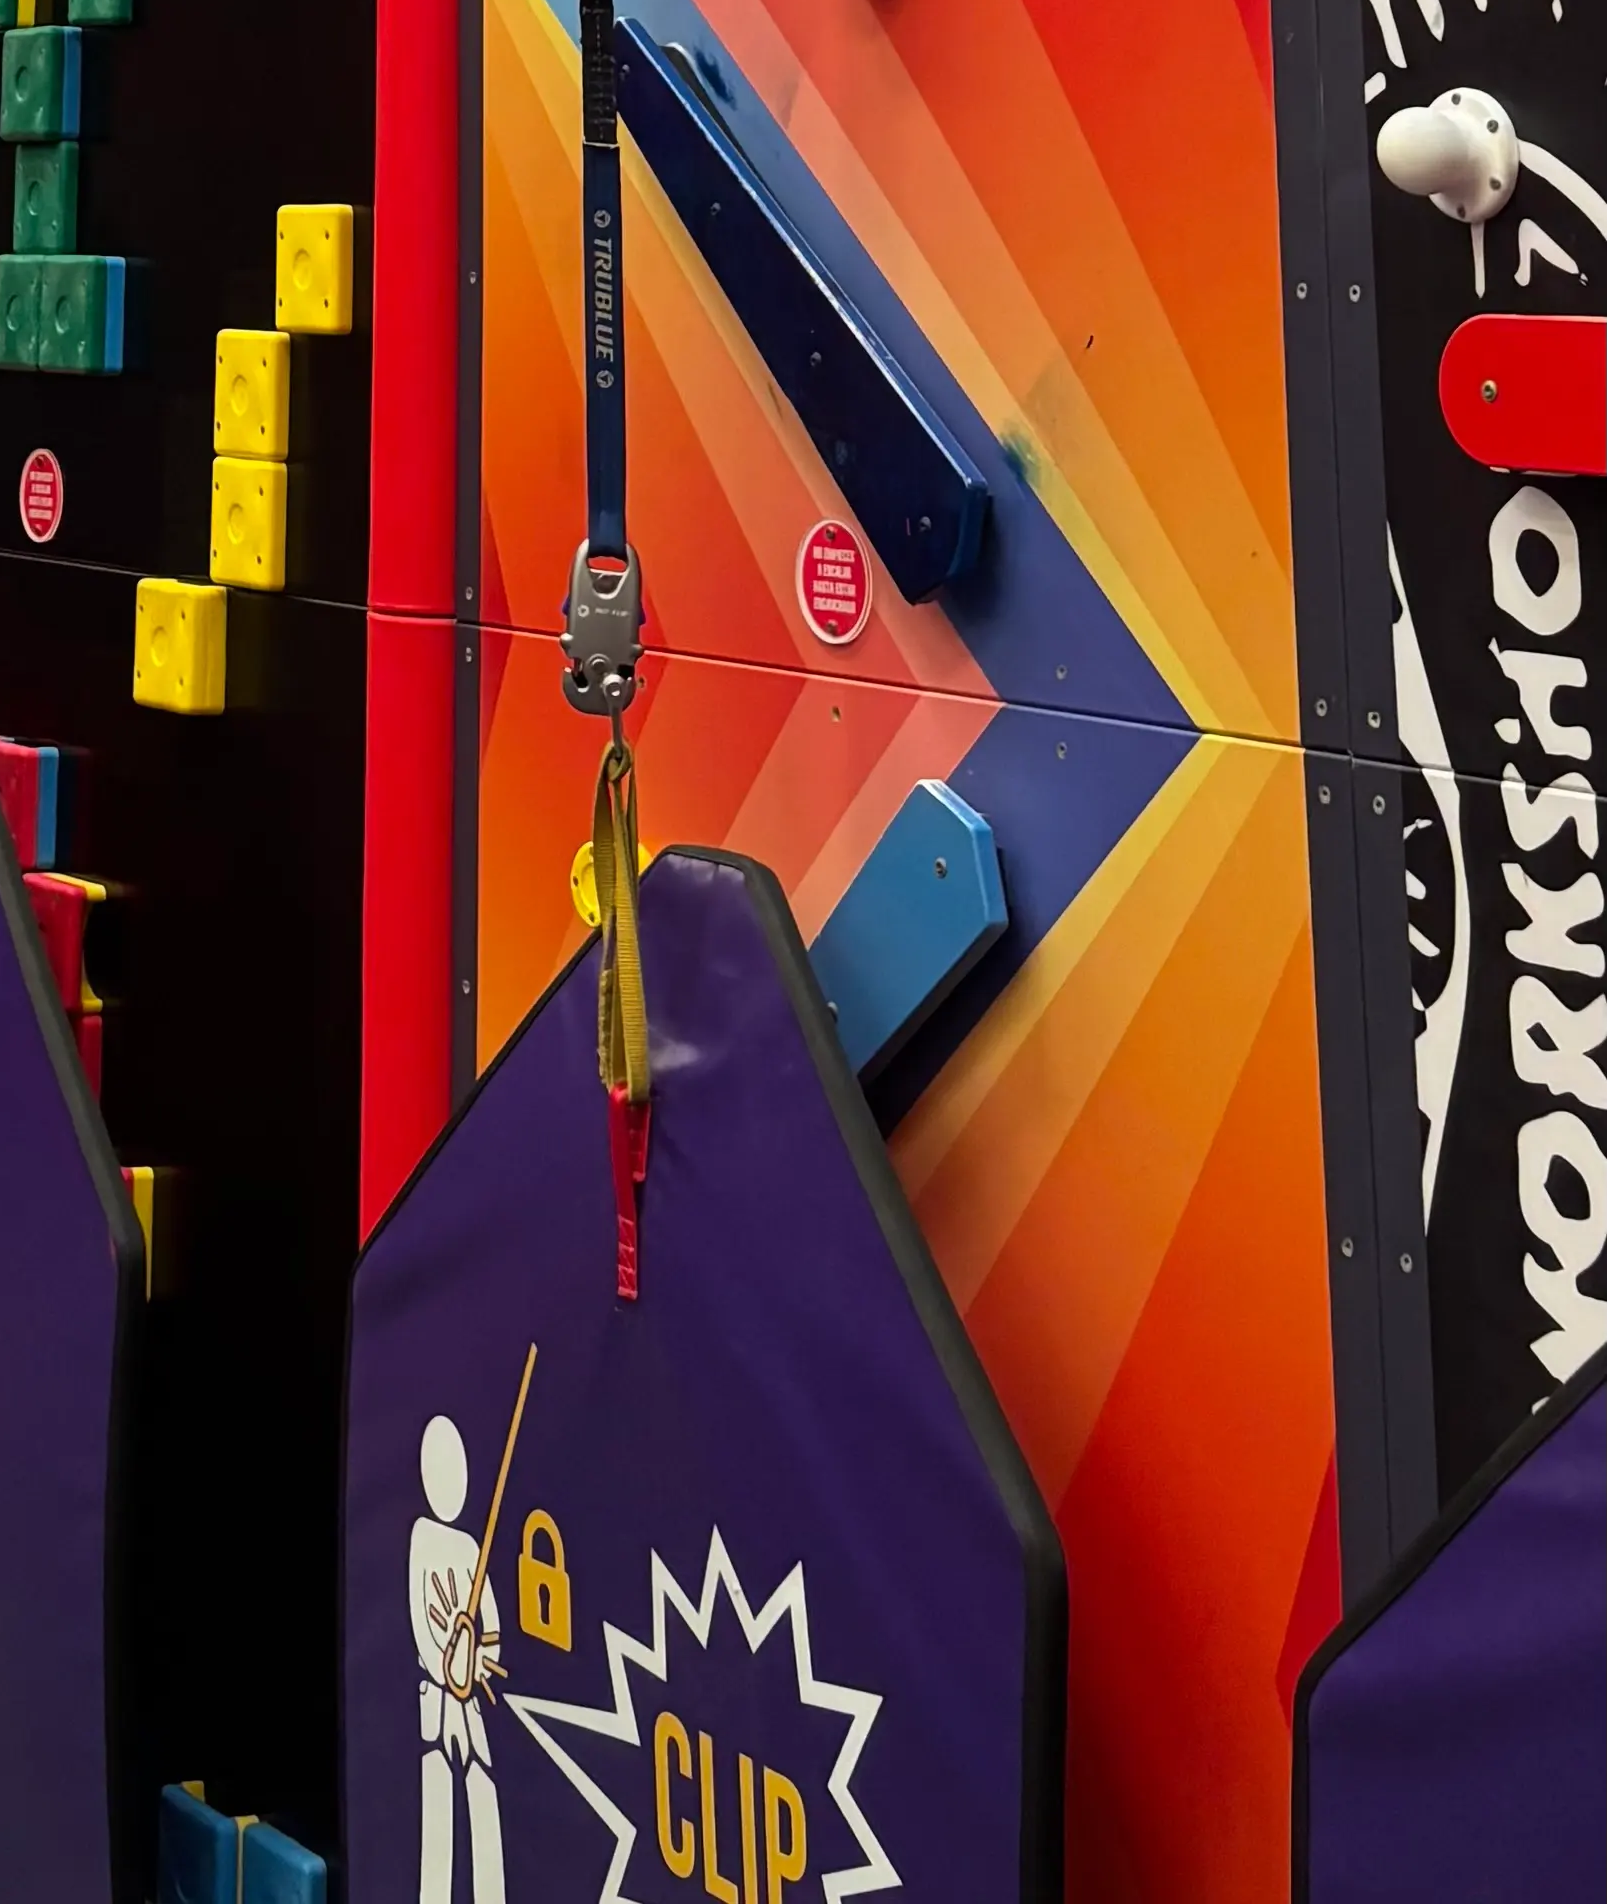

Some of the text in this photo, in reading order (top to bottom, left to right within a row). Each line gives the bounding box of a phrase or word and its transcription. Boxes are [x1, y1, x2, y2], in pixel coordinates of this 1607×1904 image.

[594, 238, 614, 363] TRUBLUE
[1488, 467, 1607, 1415] WORKSHO
[654, 1711, 807, 1904] CLIP
